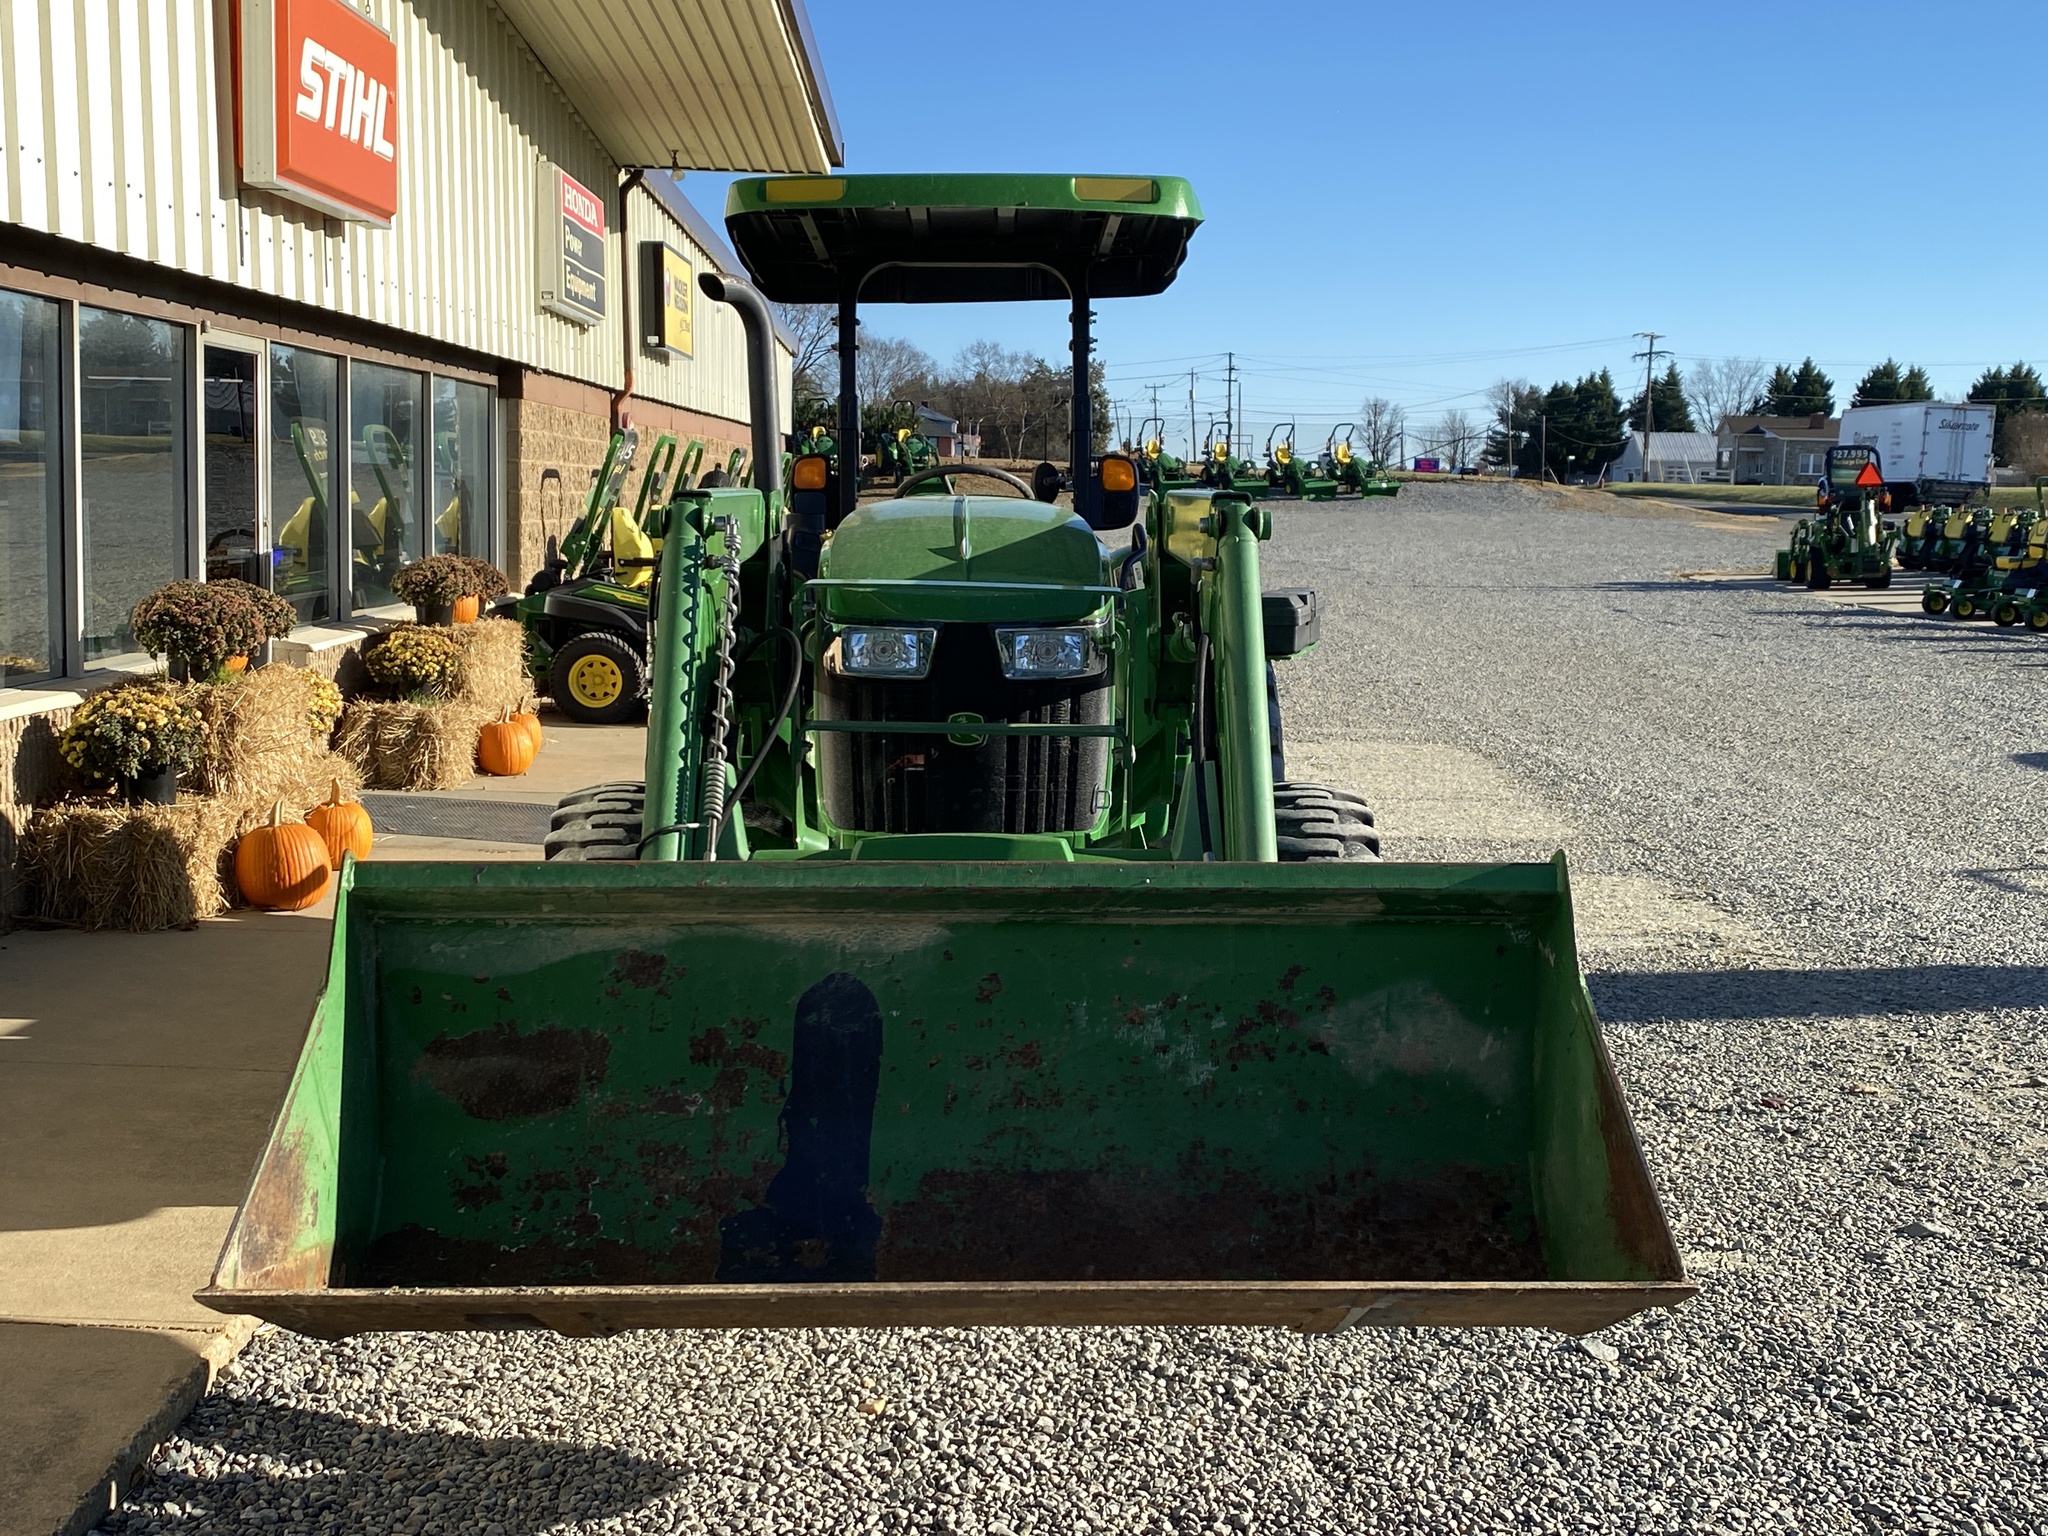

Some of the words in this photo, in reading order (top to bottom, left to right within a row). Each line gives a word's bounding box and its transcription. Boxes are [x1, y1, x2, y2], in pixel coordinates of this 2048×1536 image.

[296, 36, 394, 162] STIHL
[564, 182, 599, 228] HONDA
[565, 224, 583, 258] Power
[566, 264, 597, 303] Equipment
